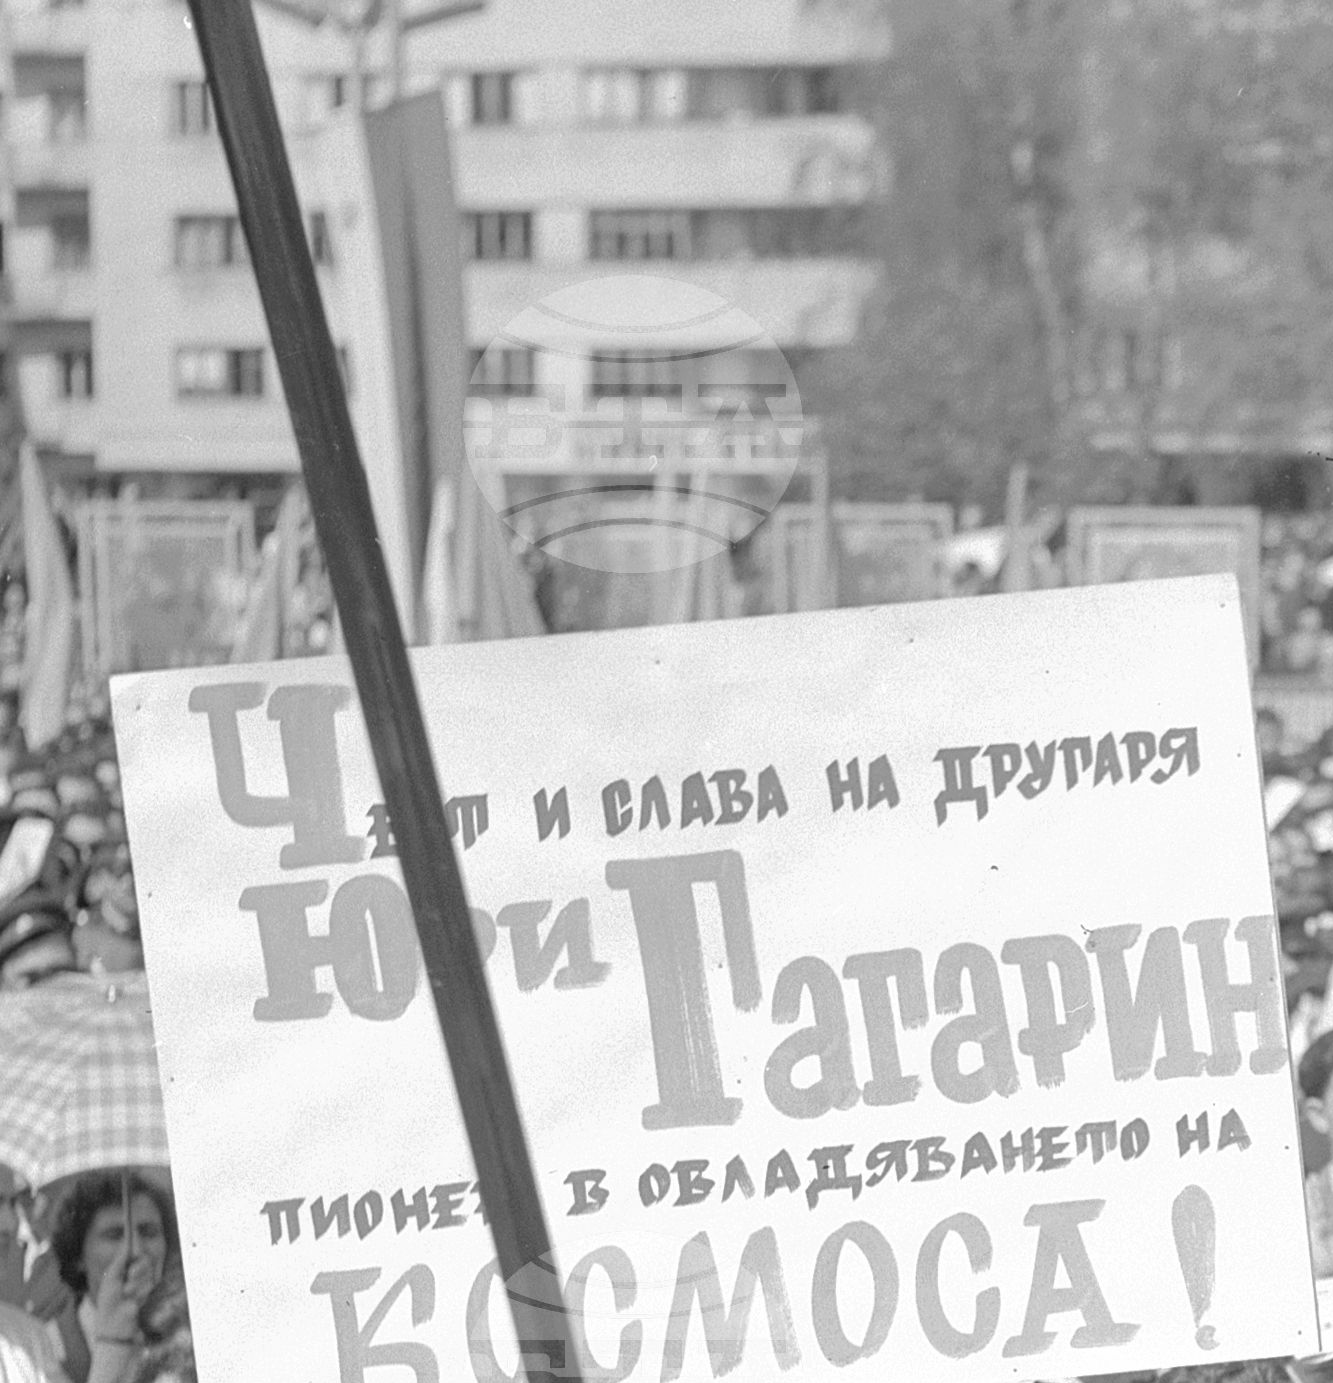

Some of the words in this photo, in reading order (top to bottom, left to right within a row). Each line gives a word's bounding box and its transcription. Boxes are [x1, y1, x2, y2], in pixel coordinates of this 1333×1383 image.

[533, 785, 571, 842] И
[601, 764, 789, 838] СЛАВА
[825, 753, 900, 814] НА
[933, 726, 1201, 828] ДРУГАРЯ
[604, 848, 1288, 1131] Гагарин
[260, 1180, 492, 1246] ПИОНЕ
[562, 1168, 610, 1217] В
[638, 1117, 1151, 1210] ОВЛАДЯВАНЕТО
[1176, 1107, 1252, 1159] НА
